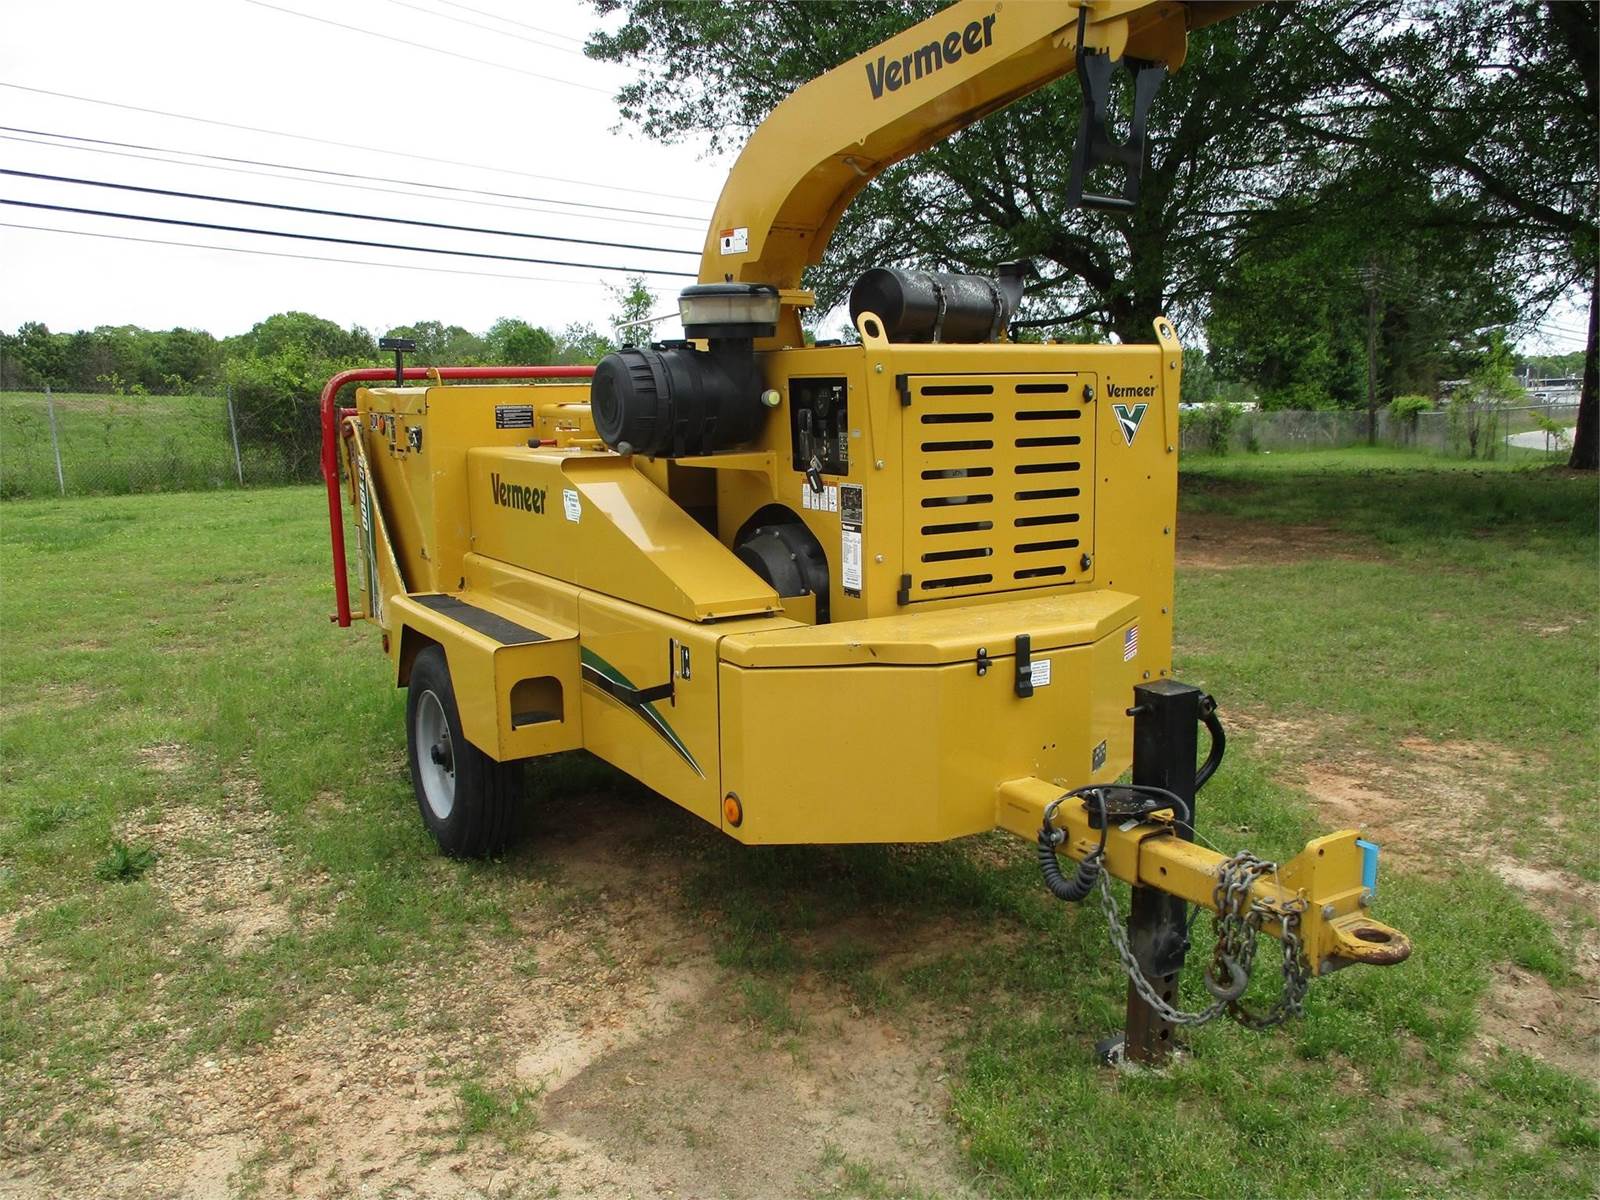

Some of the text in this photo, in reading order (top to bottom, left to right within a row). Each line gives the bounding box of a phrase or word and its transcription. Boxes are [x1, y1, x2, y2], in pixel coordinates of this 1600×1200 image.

[865, 13, 996, 100] Vermeer
[1107, 384, 1155, 397] Vermeer
[491, 472, 546, 515] Vermeer
